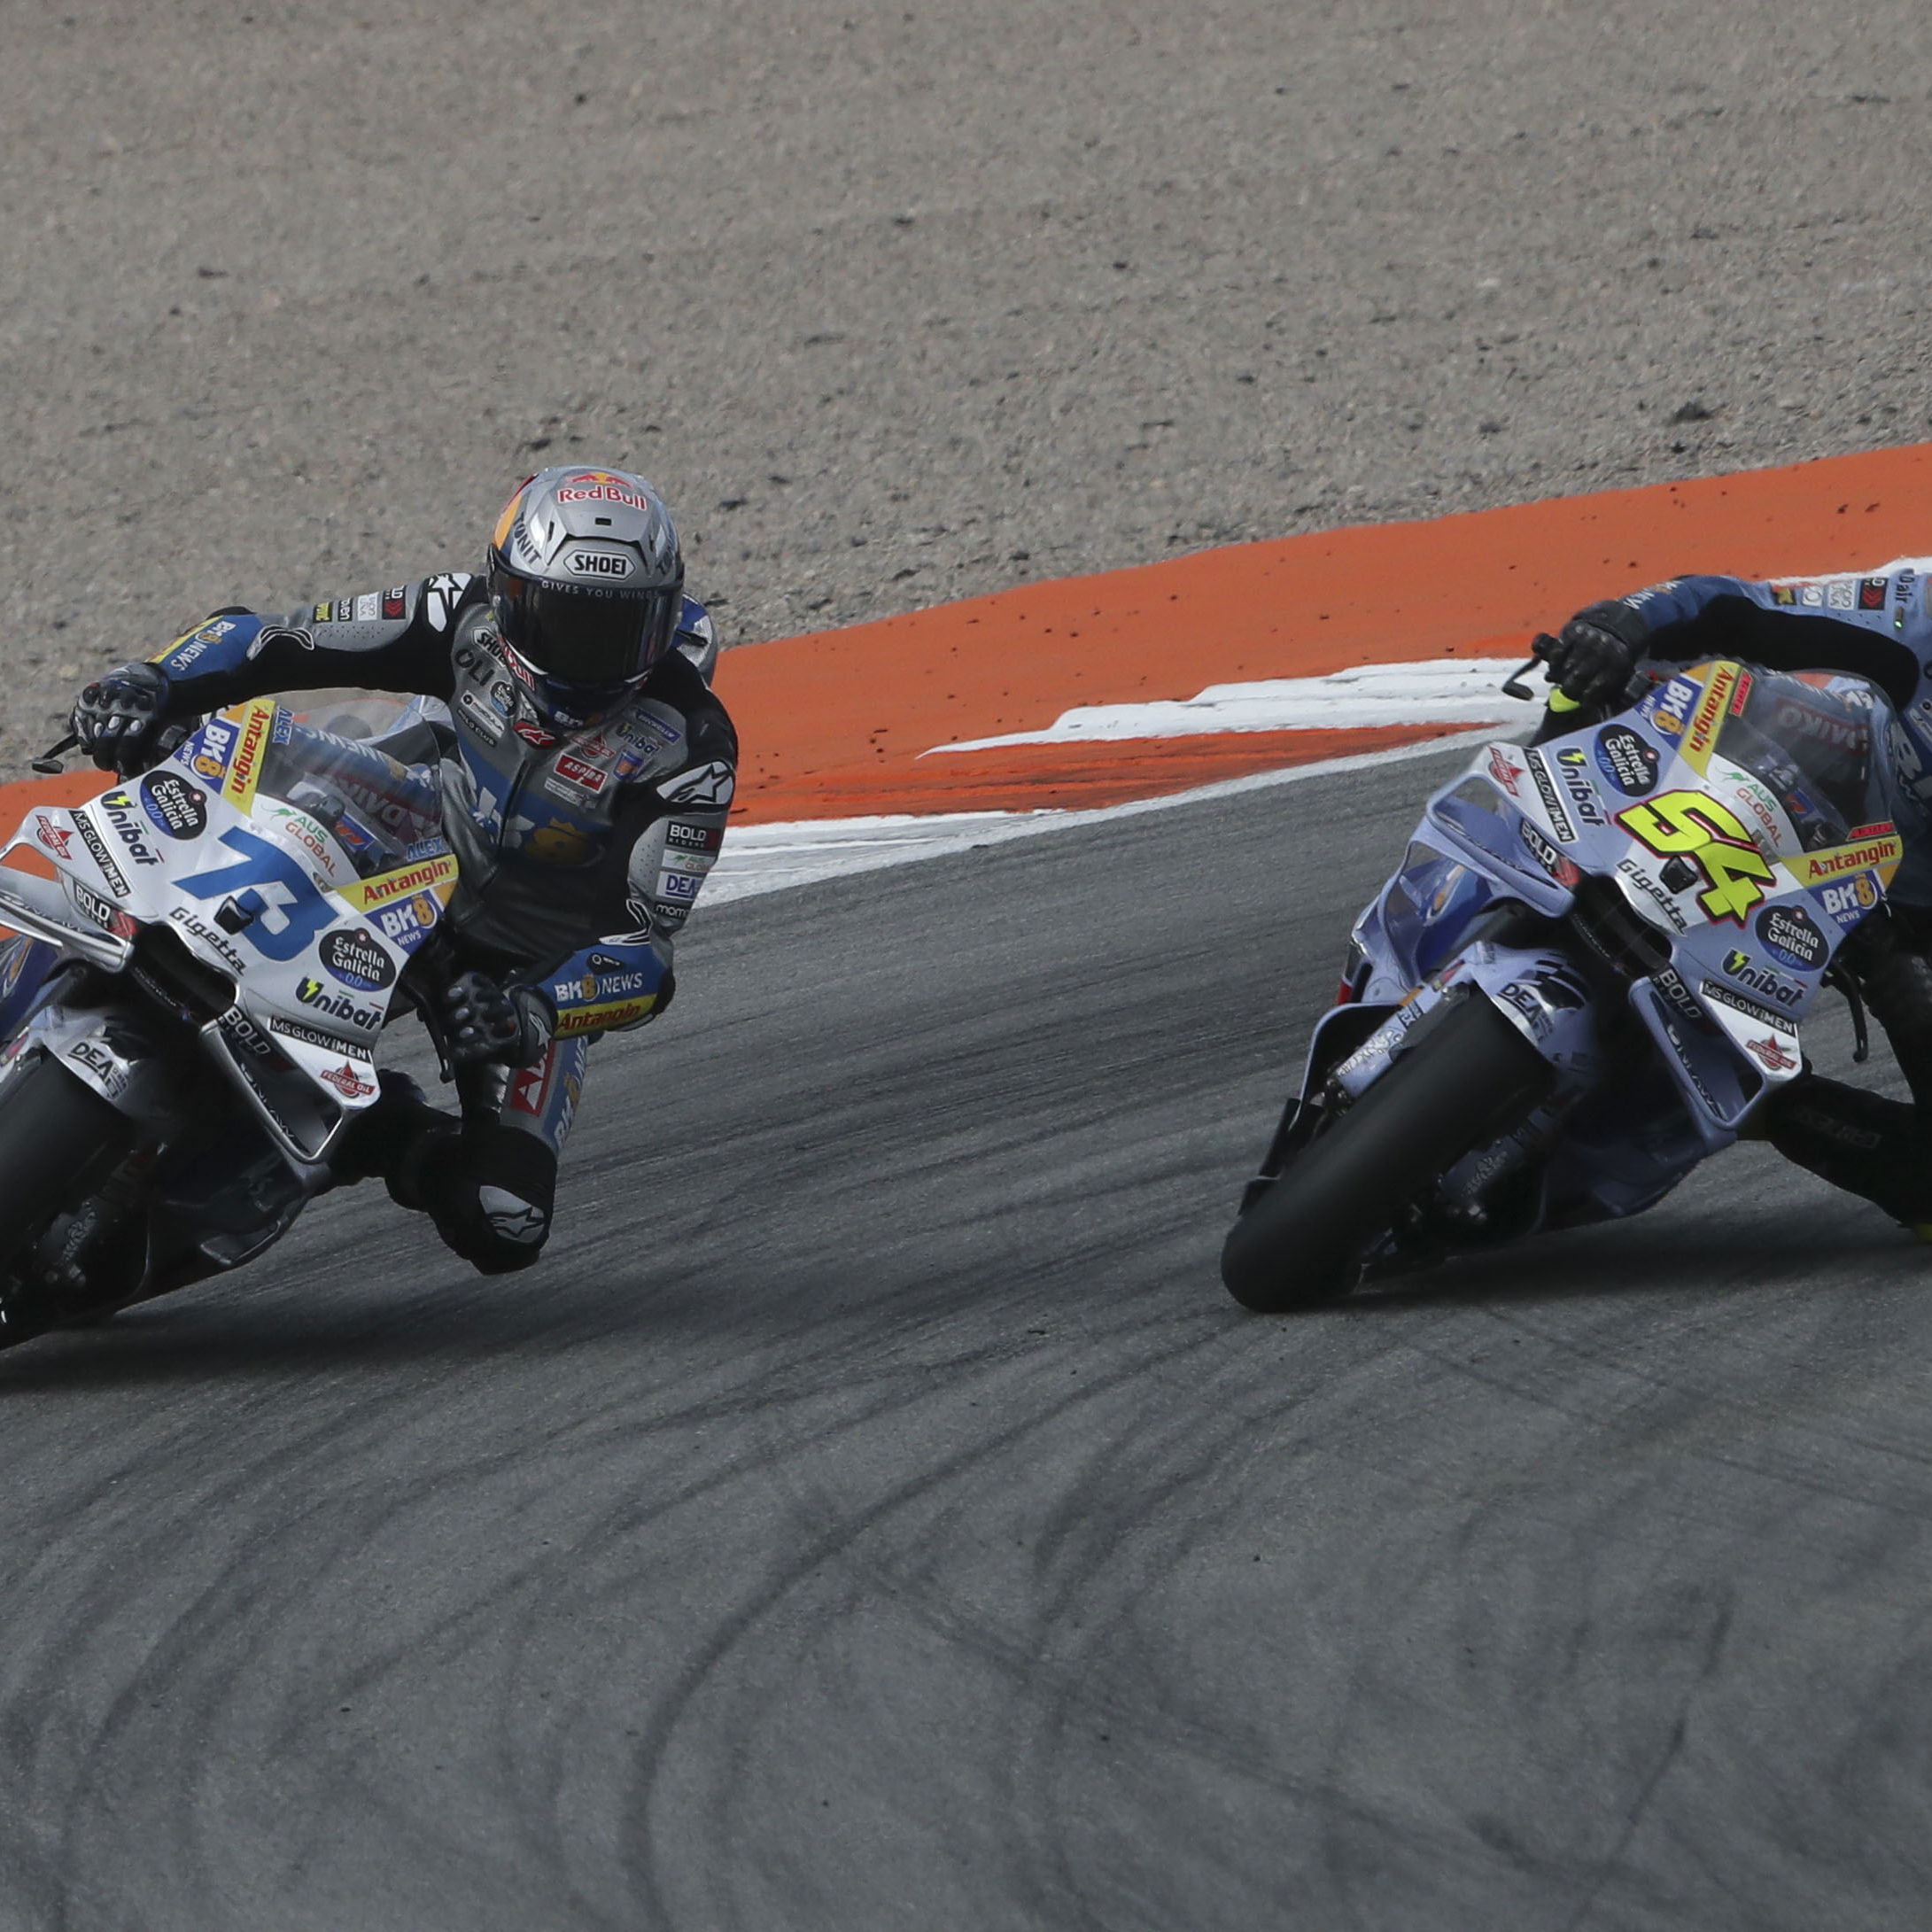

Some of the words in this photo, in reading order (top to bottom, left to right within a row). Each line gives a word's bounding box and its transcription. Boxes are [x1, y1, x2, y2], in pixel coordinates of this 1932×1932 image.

[557, 485, 602, 504] Red
[605, 487, 648, 511] Bull
[573, 554, 627, 576] SHOEI
[541, 579, 578, 594] GIVES
[586, 587, 613, 599] YOU
[170, 639, 209, 672] NEWS
[272, 705, 295, 745] ALEX
[1649, 679, 1694, 736] BK8
[1689, 665, 1735, 753] Antangin
[180, 741, 196, 766] NEWS
[190, 722, 232, 780] BK8
[230, 705, 271, 795] Antangin
[1605, 738, 1636, 787] Galicia
[1618, 733, 1651, 786] Estrella
[151, 784, 183, 830] Galicia
[163, 779, 199, 827] Estrella
[1556, 747, 1606, 826] Unibat
[1747, 783, 1777, 812] AUS
[100, 790, 159, 866] Unibat
[294, 815, 329, 843] AUS
[670, 823, 707, 842] BOLD
[1735, 787, 1782, 849] GLOBAL
[284, 821, 338, 879] GLOBAL
[406, 837, 446, 862] ALEX
[1522, 820, 1556, 865] BOLD
[1614, 788, 1777, 930] 54
[1808, 842, 1896, 880] Antangin
[170, 826, 340, 962] 73
[363, 860, 451, 905] Antangin
[1617, 858, 1688, 937] Gigetta
[1821, 873, 1879, 914] BK8
[75, 887, 112, 920] BOLD
[380, 893, 438, 939] BK8
[1836, 909, 1861, 924] NEWS
[169, 906, 247, 976] Gigetta
[397, 930, 422, 947] NEWS
[1767, 927, 1814, 961] Galicia
[1769, 912, 1819, 949] Estrella
[332, 952, 381, 982] Galicia
[333, 936, 385, 969] Estrella
[554, 974, 598, 1002] BK8
[601, 973, 644, 994] NEWS
[1659, 969, 1703, 1018] BOLD
[1721, 947, 1804, 1006] Unibat
[295, 975, 381, 1030] Unibat
[558, 1003, 641, 1030] Antangin
[1722, 989, 1762, 1017] GLOW
[223, 1005, 271, 1055] BOLD
[271, 1019, 291, 1035] MS
[291, 1026, 331, 1048] GLOW
[333, 1039, 368, 1060] MEN
[71, 1042, 114, 1081] DEA
[322, 1070, 356, 1090] FEDERAL
